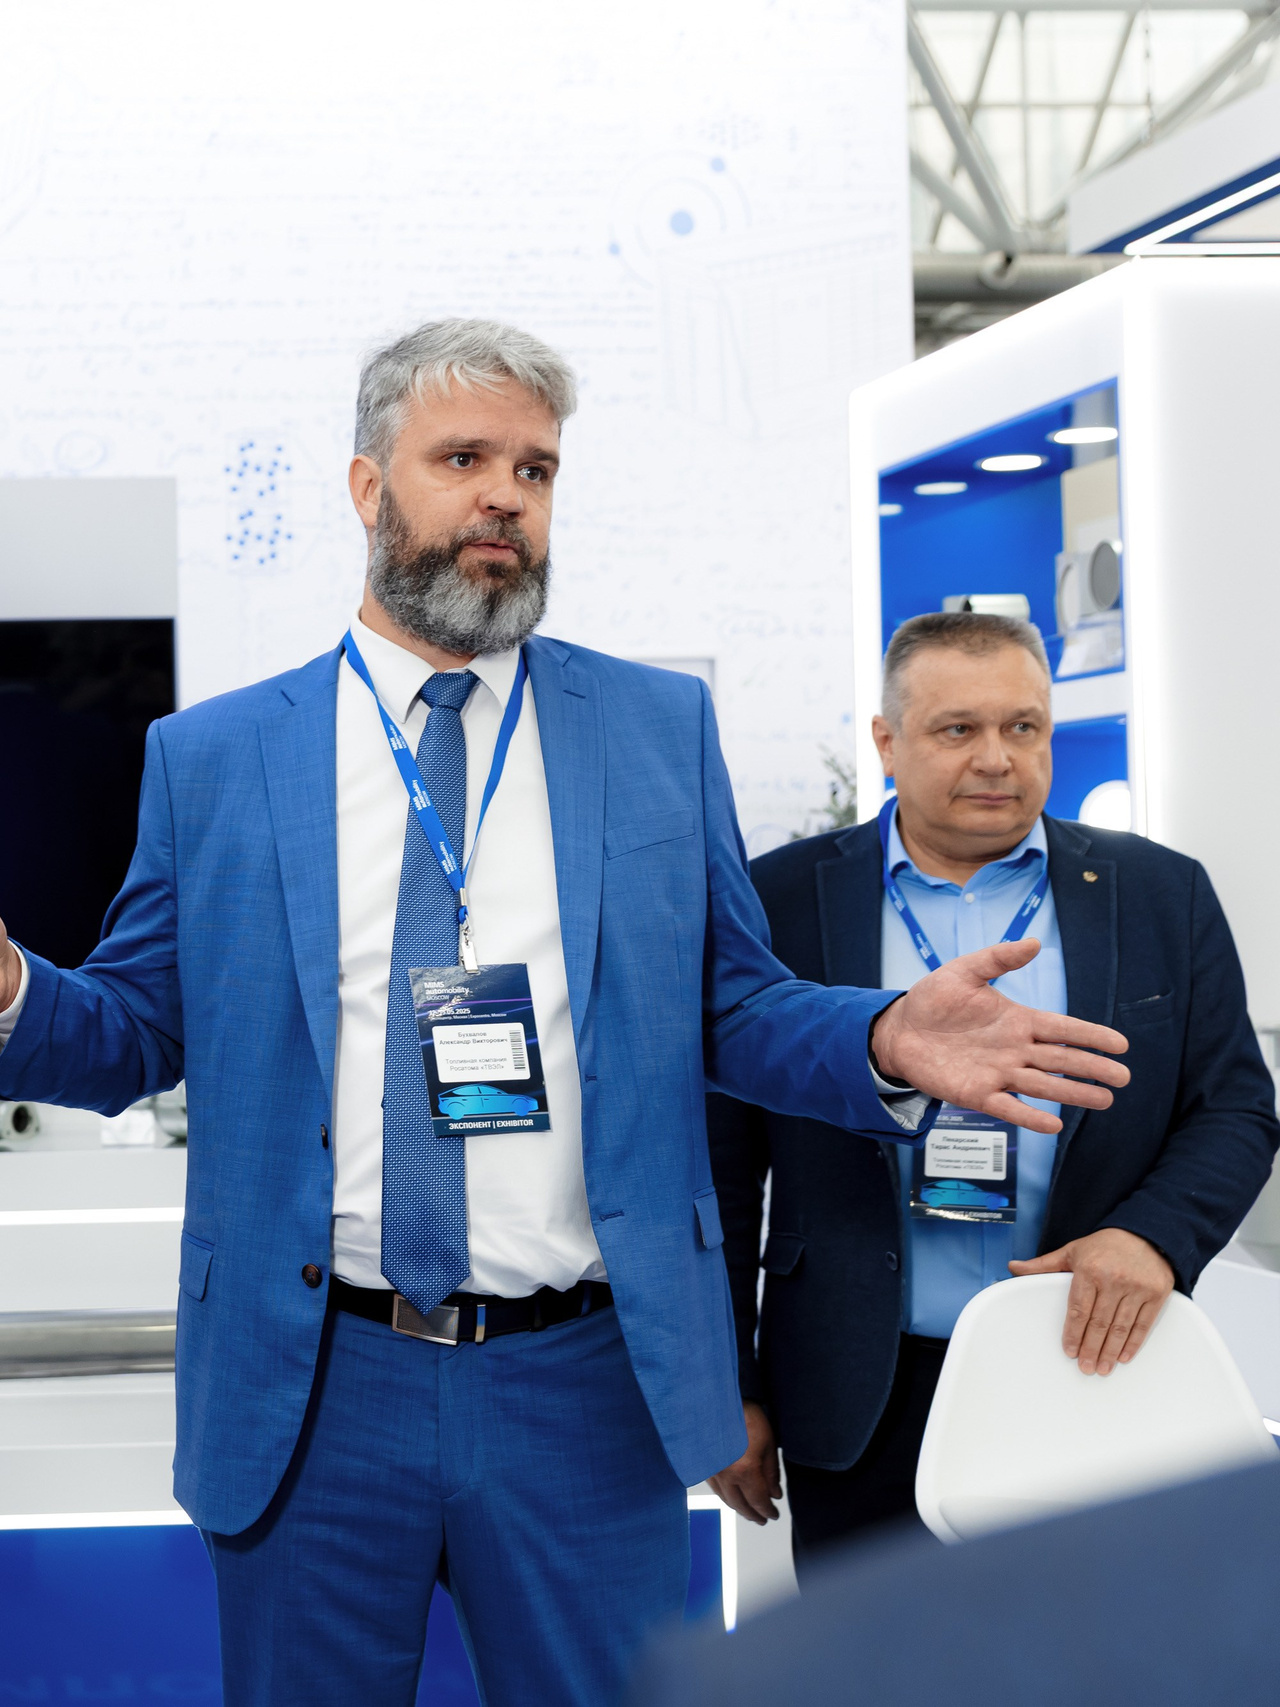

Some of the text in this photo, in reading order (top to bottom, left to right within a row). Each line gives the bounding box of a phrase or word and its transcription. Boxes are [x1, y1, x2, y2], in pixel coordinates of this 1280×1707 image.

[412, 779, 427, 808] automobility
[413, 796, 422, 811] MIMS
[424, 981, 445, 989] MIMS
[425, 986, 470, 995] automobility
[448, 1119, 534, 1130] ЭКСПОНЕНТ EXHIBITOR
